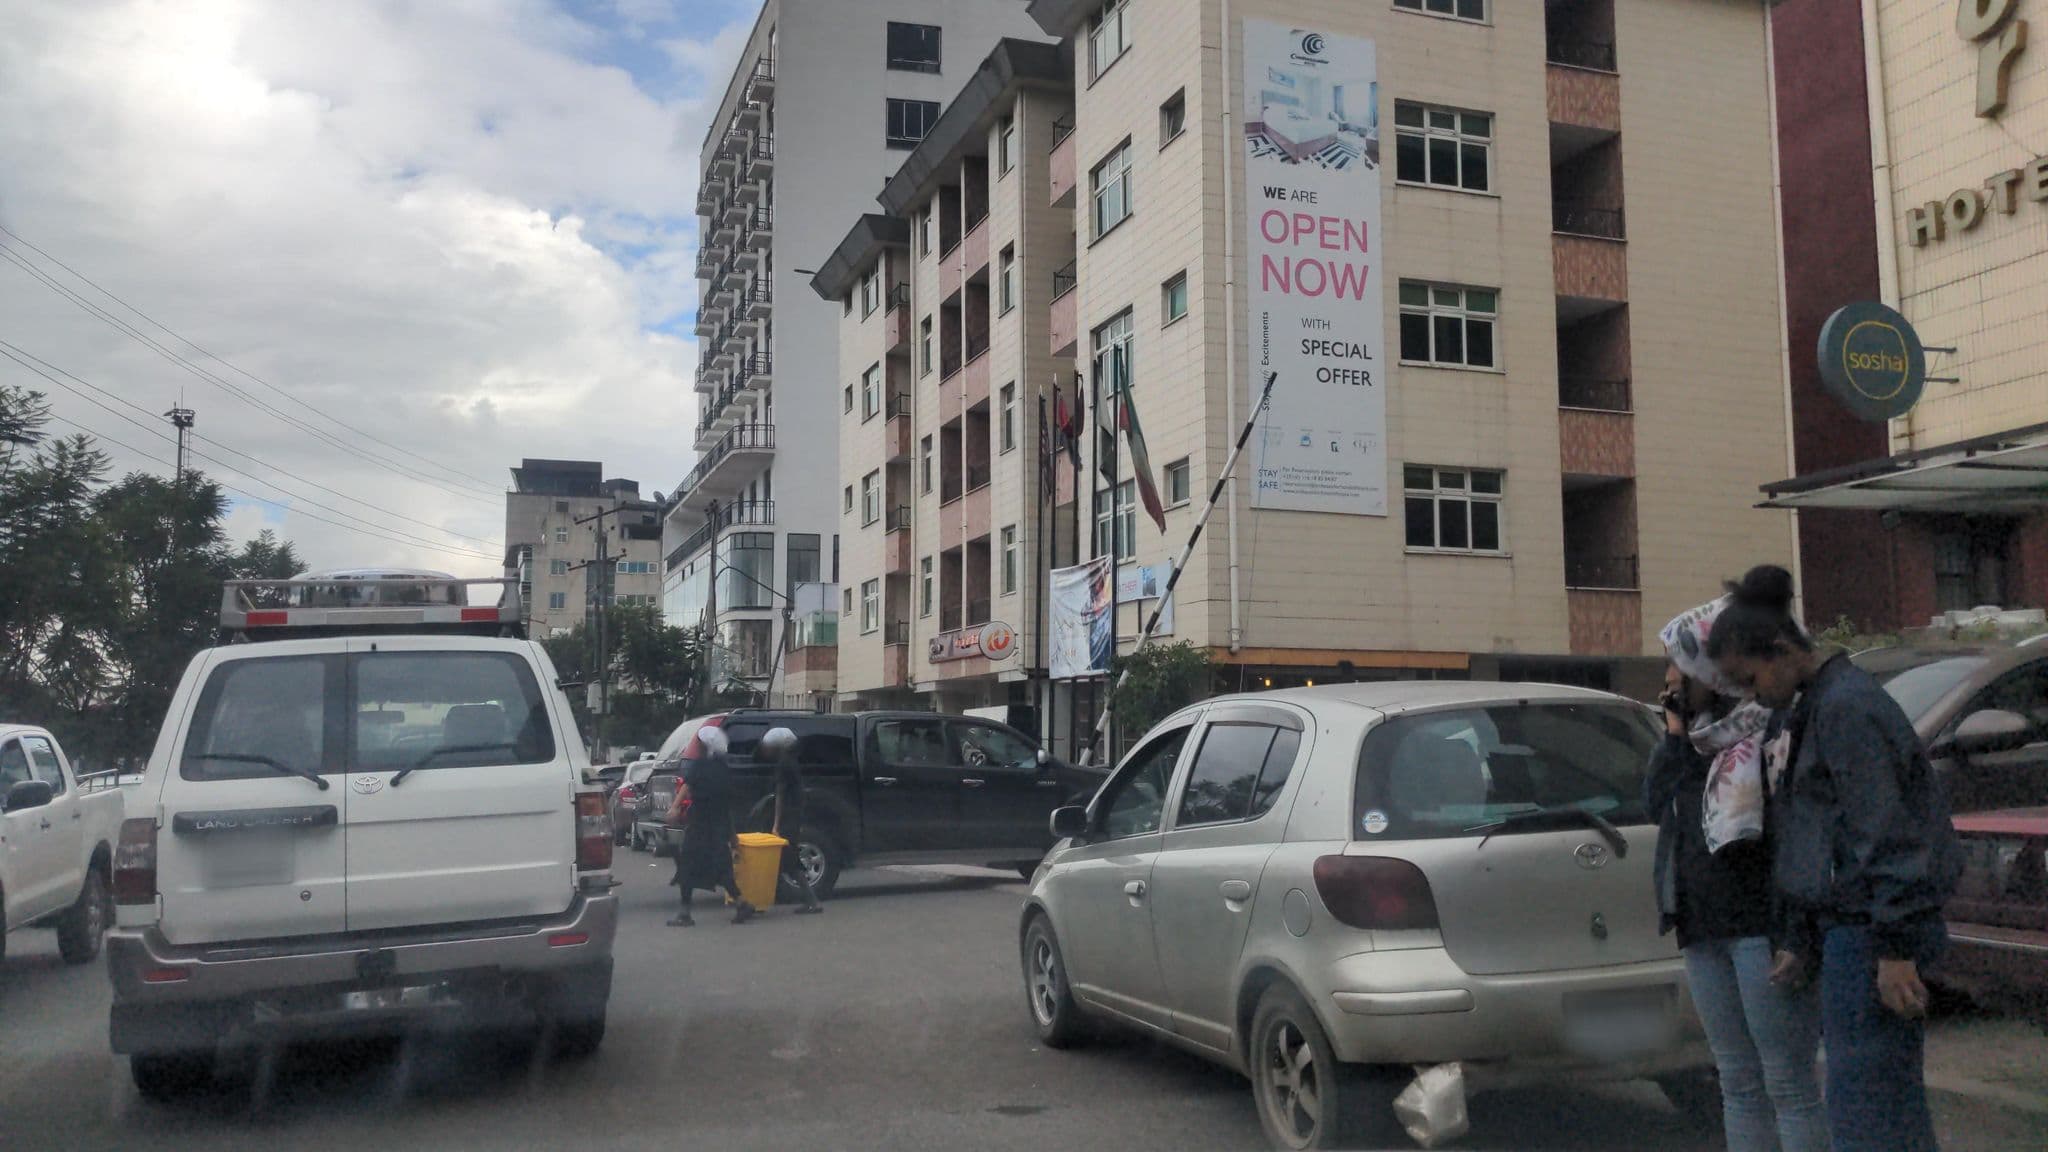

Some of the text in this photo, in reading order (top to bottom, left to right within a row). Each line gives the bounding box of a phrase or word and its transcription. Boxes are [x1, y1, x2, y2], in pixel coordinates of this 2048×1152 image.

[1263, 186, 1318, 204] WE ARE
[1261, 209, 1368, 253] OPEN
[1262, 254, 1369, 301] NOW
[1301, 318, 1331, 330] WITH
[1261, 311, 1269, 366] Excitements
[1301, 339, 1372, 360] SPECIAL
[1849, 350, 1905, 372] sosha
[1316, 367, 1372, 387] OFFER
[1258, 469, 1278, 478] STAY
[1258, 481, 1278, 489] SAFE
